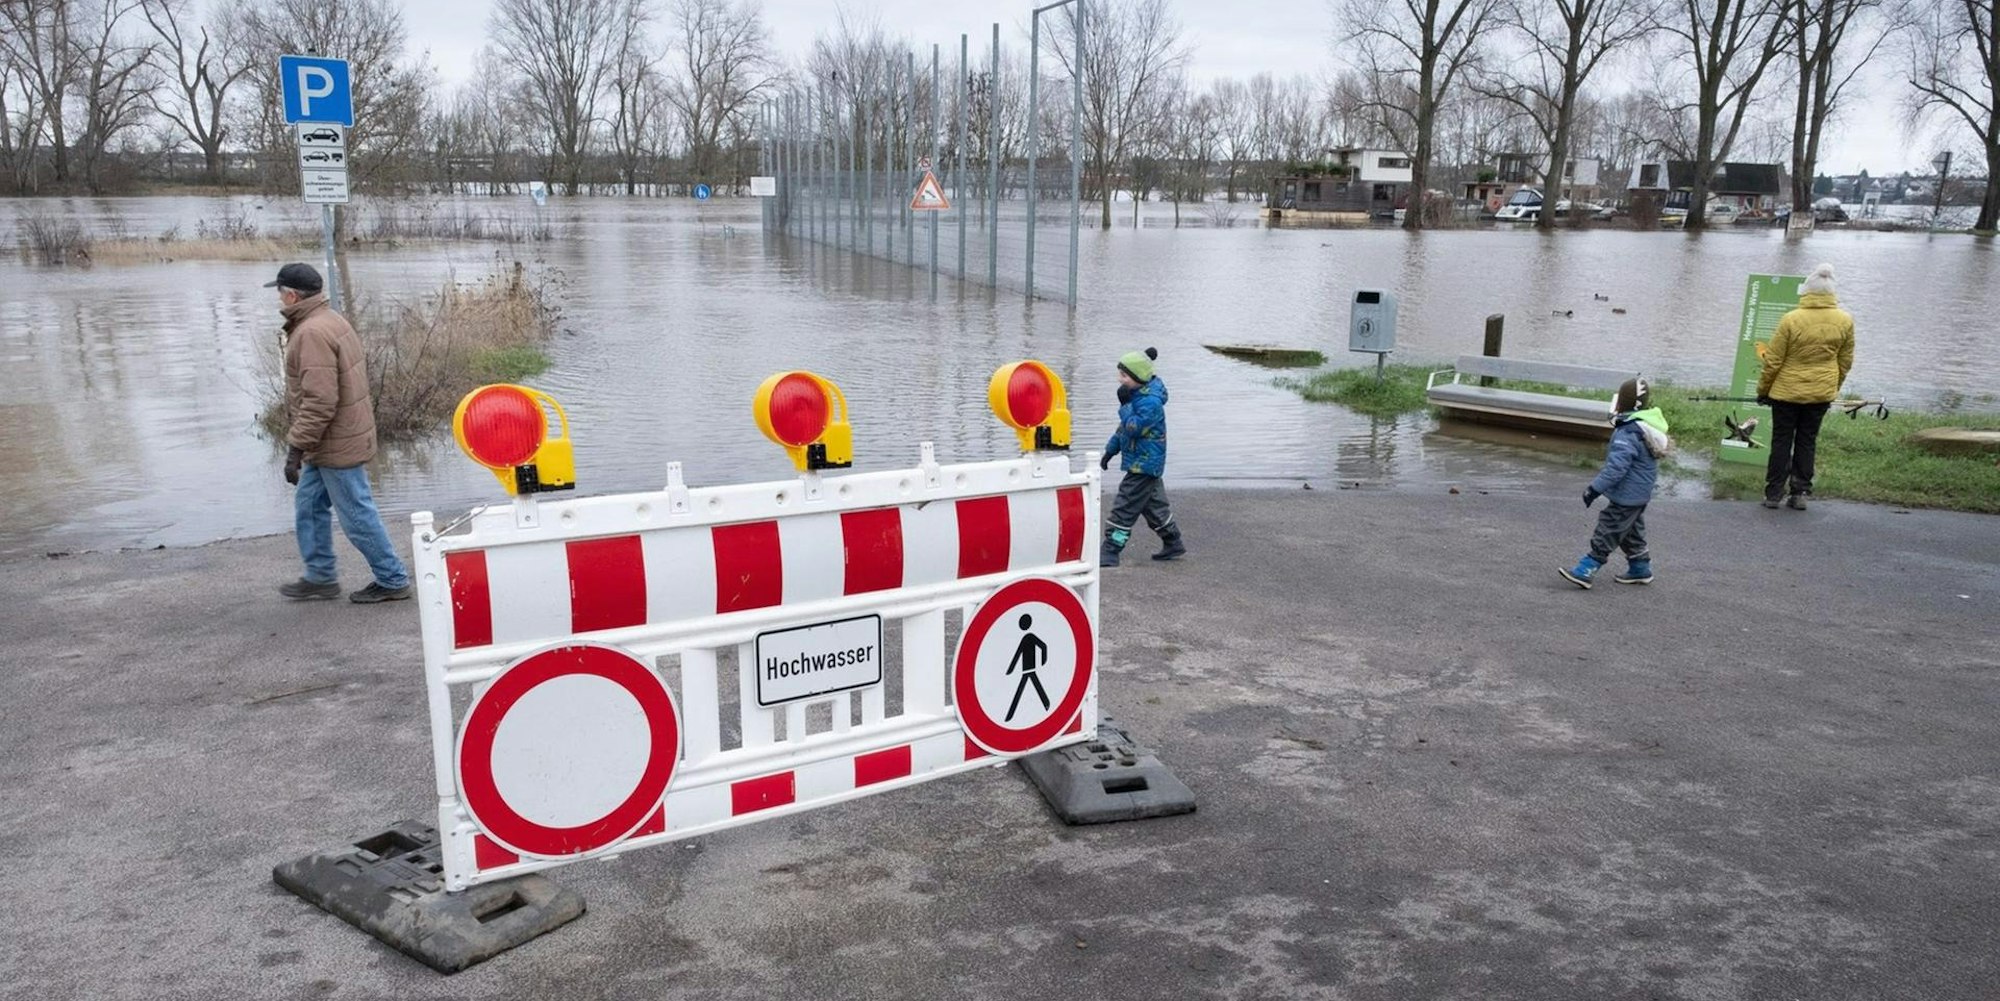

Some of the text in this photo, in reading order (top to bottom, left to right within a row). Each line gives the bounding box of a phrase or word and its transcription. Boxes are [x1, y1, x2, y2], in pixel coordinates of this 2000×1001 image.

[298, 66, 334, 116] P
[1748, 281, 1759, 306] Werth
[767, 645, 874, 680] Hochwasser
